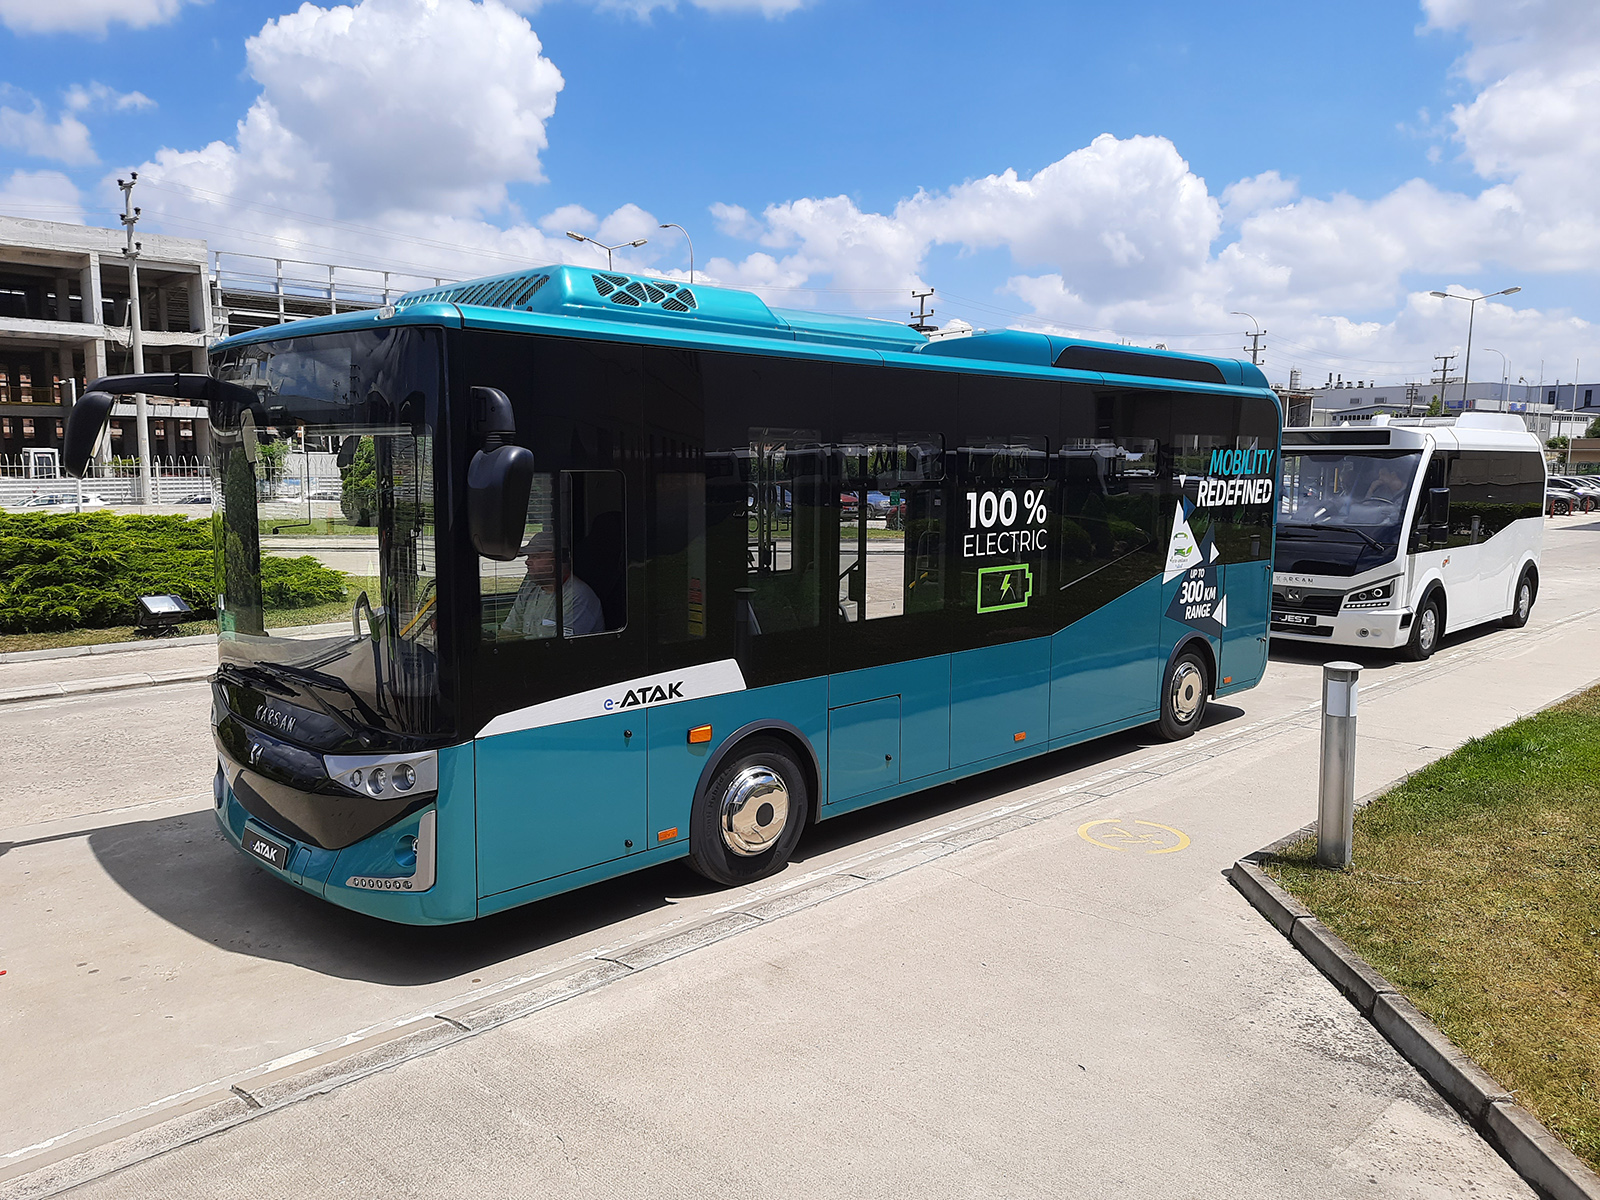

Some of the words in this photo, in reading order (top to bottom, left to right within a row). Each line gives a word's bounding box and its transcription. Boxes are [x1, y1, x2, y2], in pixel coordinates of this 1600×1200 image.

[1208, 449, 1275, 476] MOBILITY
[1196, 479, 1273, 507] REDEFINED
[966, 490, 1018, 529] 100
[1024, 489, 1047, 525] %
[963, 528, 1048, 557] ELECTRIC
[1189, 569, 1198, 579] UP
[1197, 568, 1205, 578] TO
[1179, 580, 1204, 605] 300
[1204, 586, 1217, 601] KM
[1184, 603, 1212, 620] RANGE
[603, 681, 684, 710] e-ATAK
[254, 703, 297, 733] KARSAN
